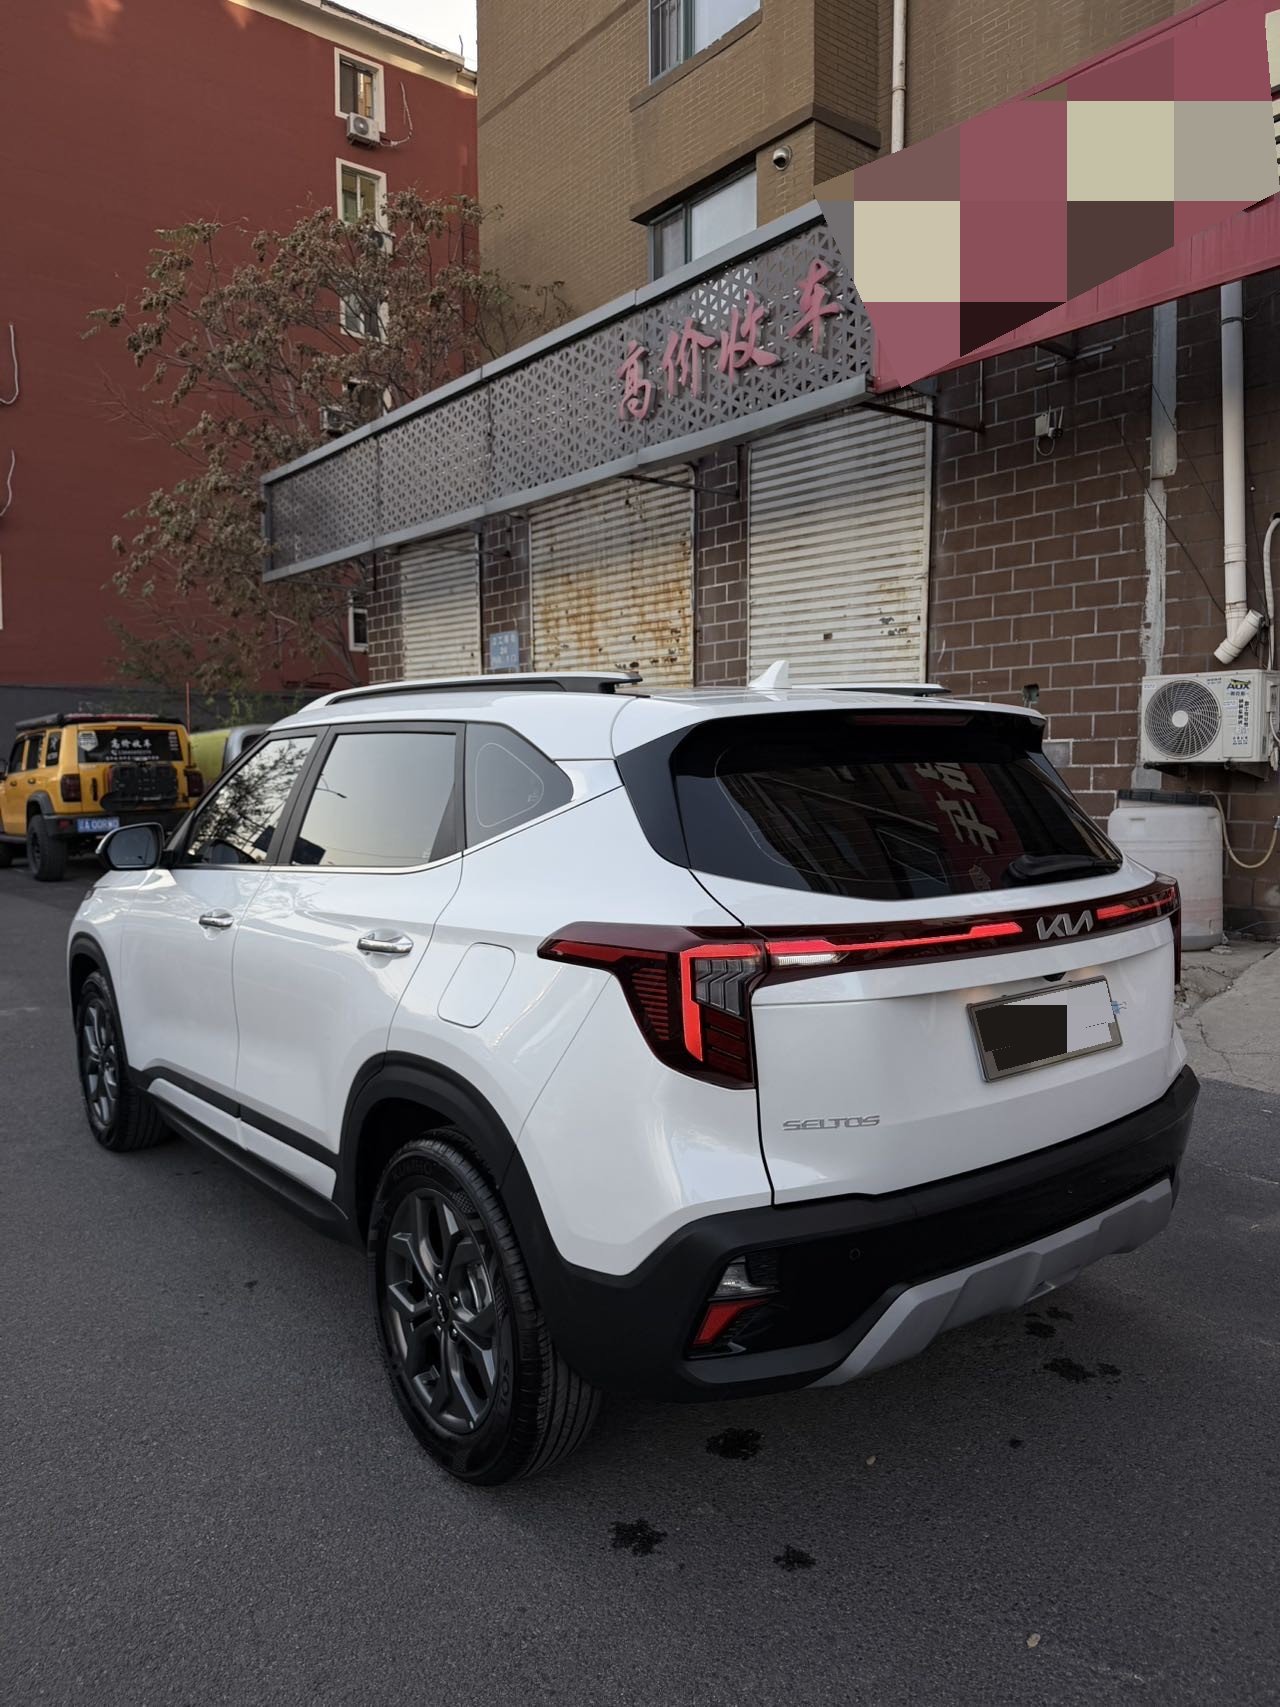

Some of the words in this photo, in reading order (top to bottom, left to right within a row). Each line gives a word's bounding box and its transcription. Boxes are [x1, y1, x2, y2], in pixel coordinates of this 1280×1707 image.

[616, 257, 845, 420] 高价收车
[1226, 679, 1251, 690] AUX
[1036, 909, 1094, 940] KIA
[783, 1115, 880, 1131] SELTOS
